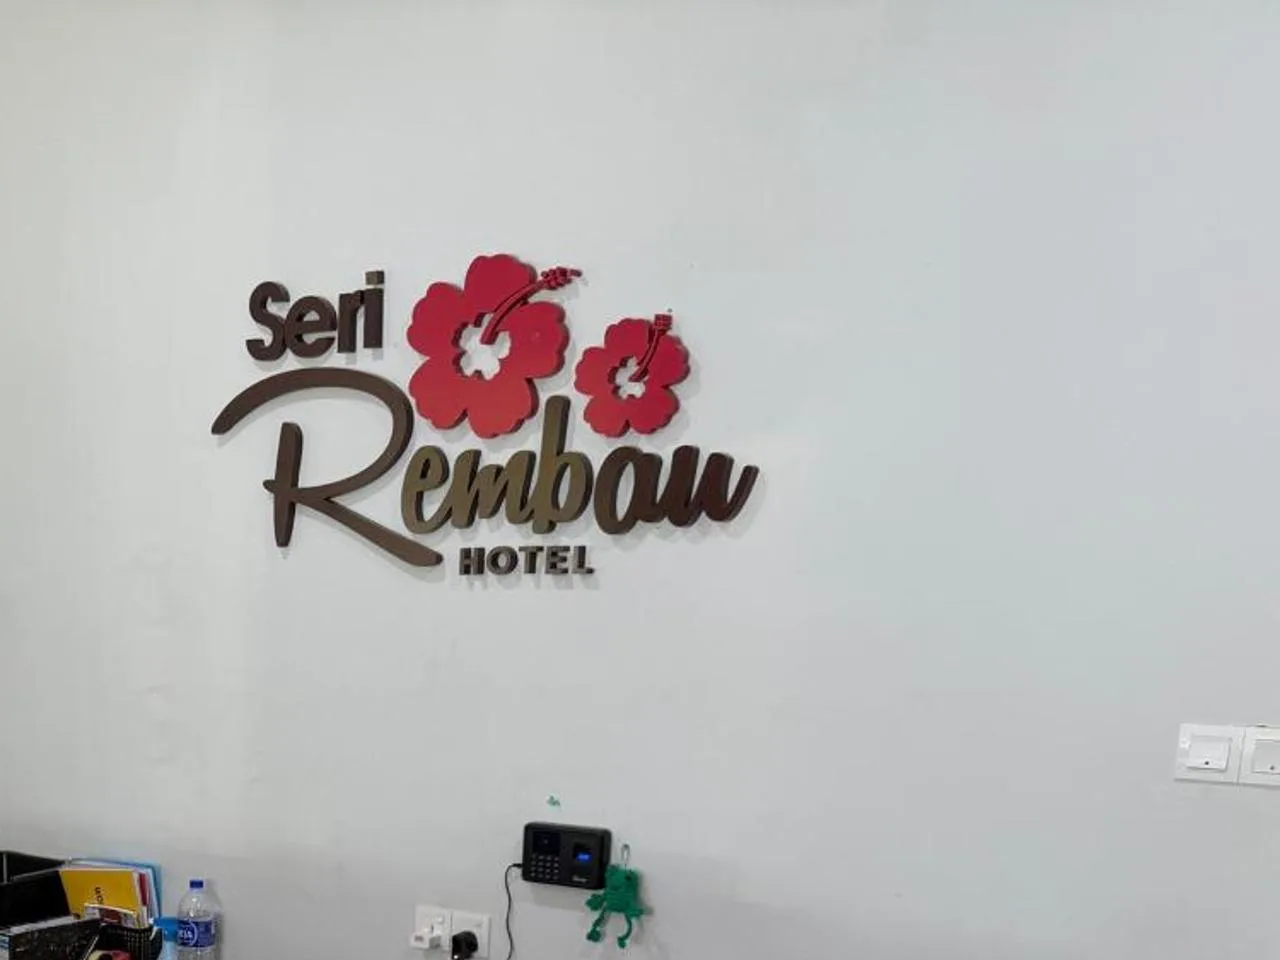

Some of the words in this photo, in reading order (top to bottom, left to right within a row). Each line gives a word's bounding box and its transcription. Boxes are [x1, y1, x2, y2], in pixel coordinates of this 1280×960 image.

[245, 270, 385, 362] Seri
[211, 366, 760, 568] Rembau
[458, 545, 595, 575] HOTEL
